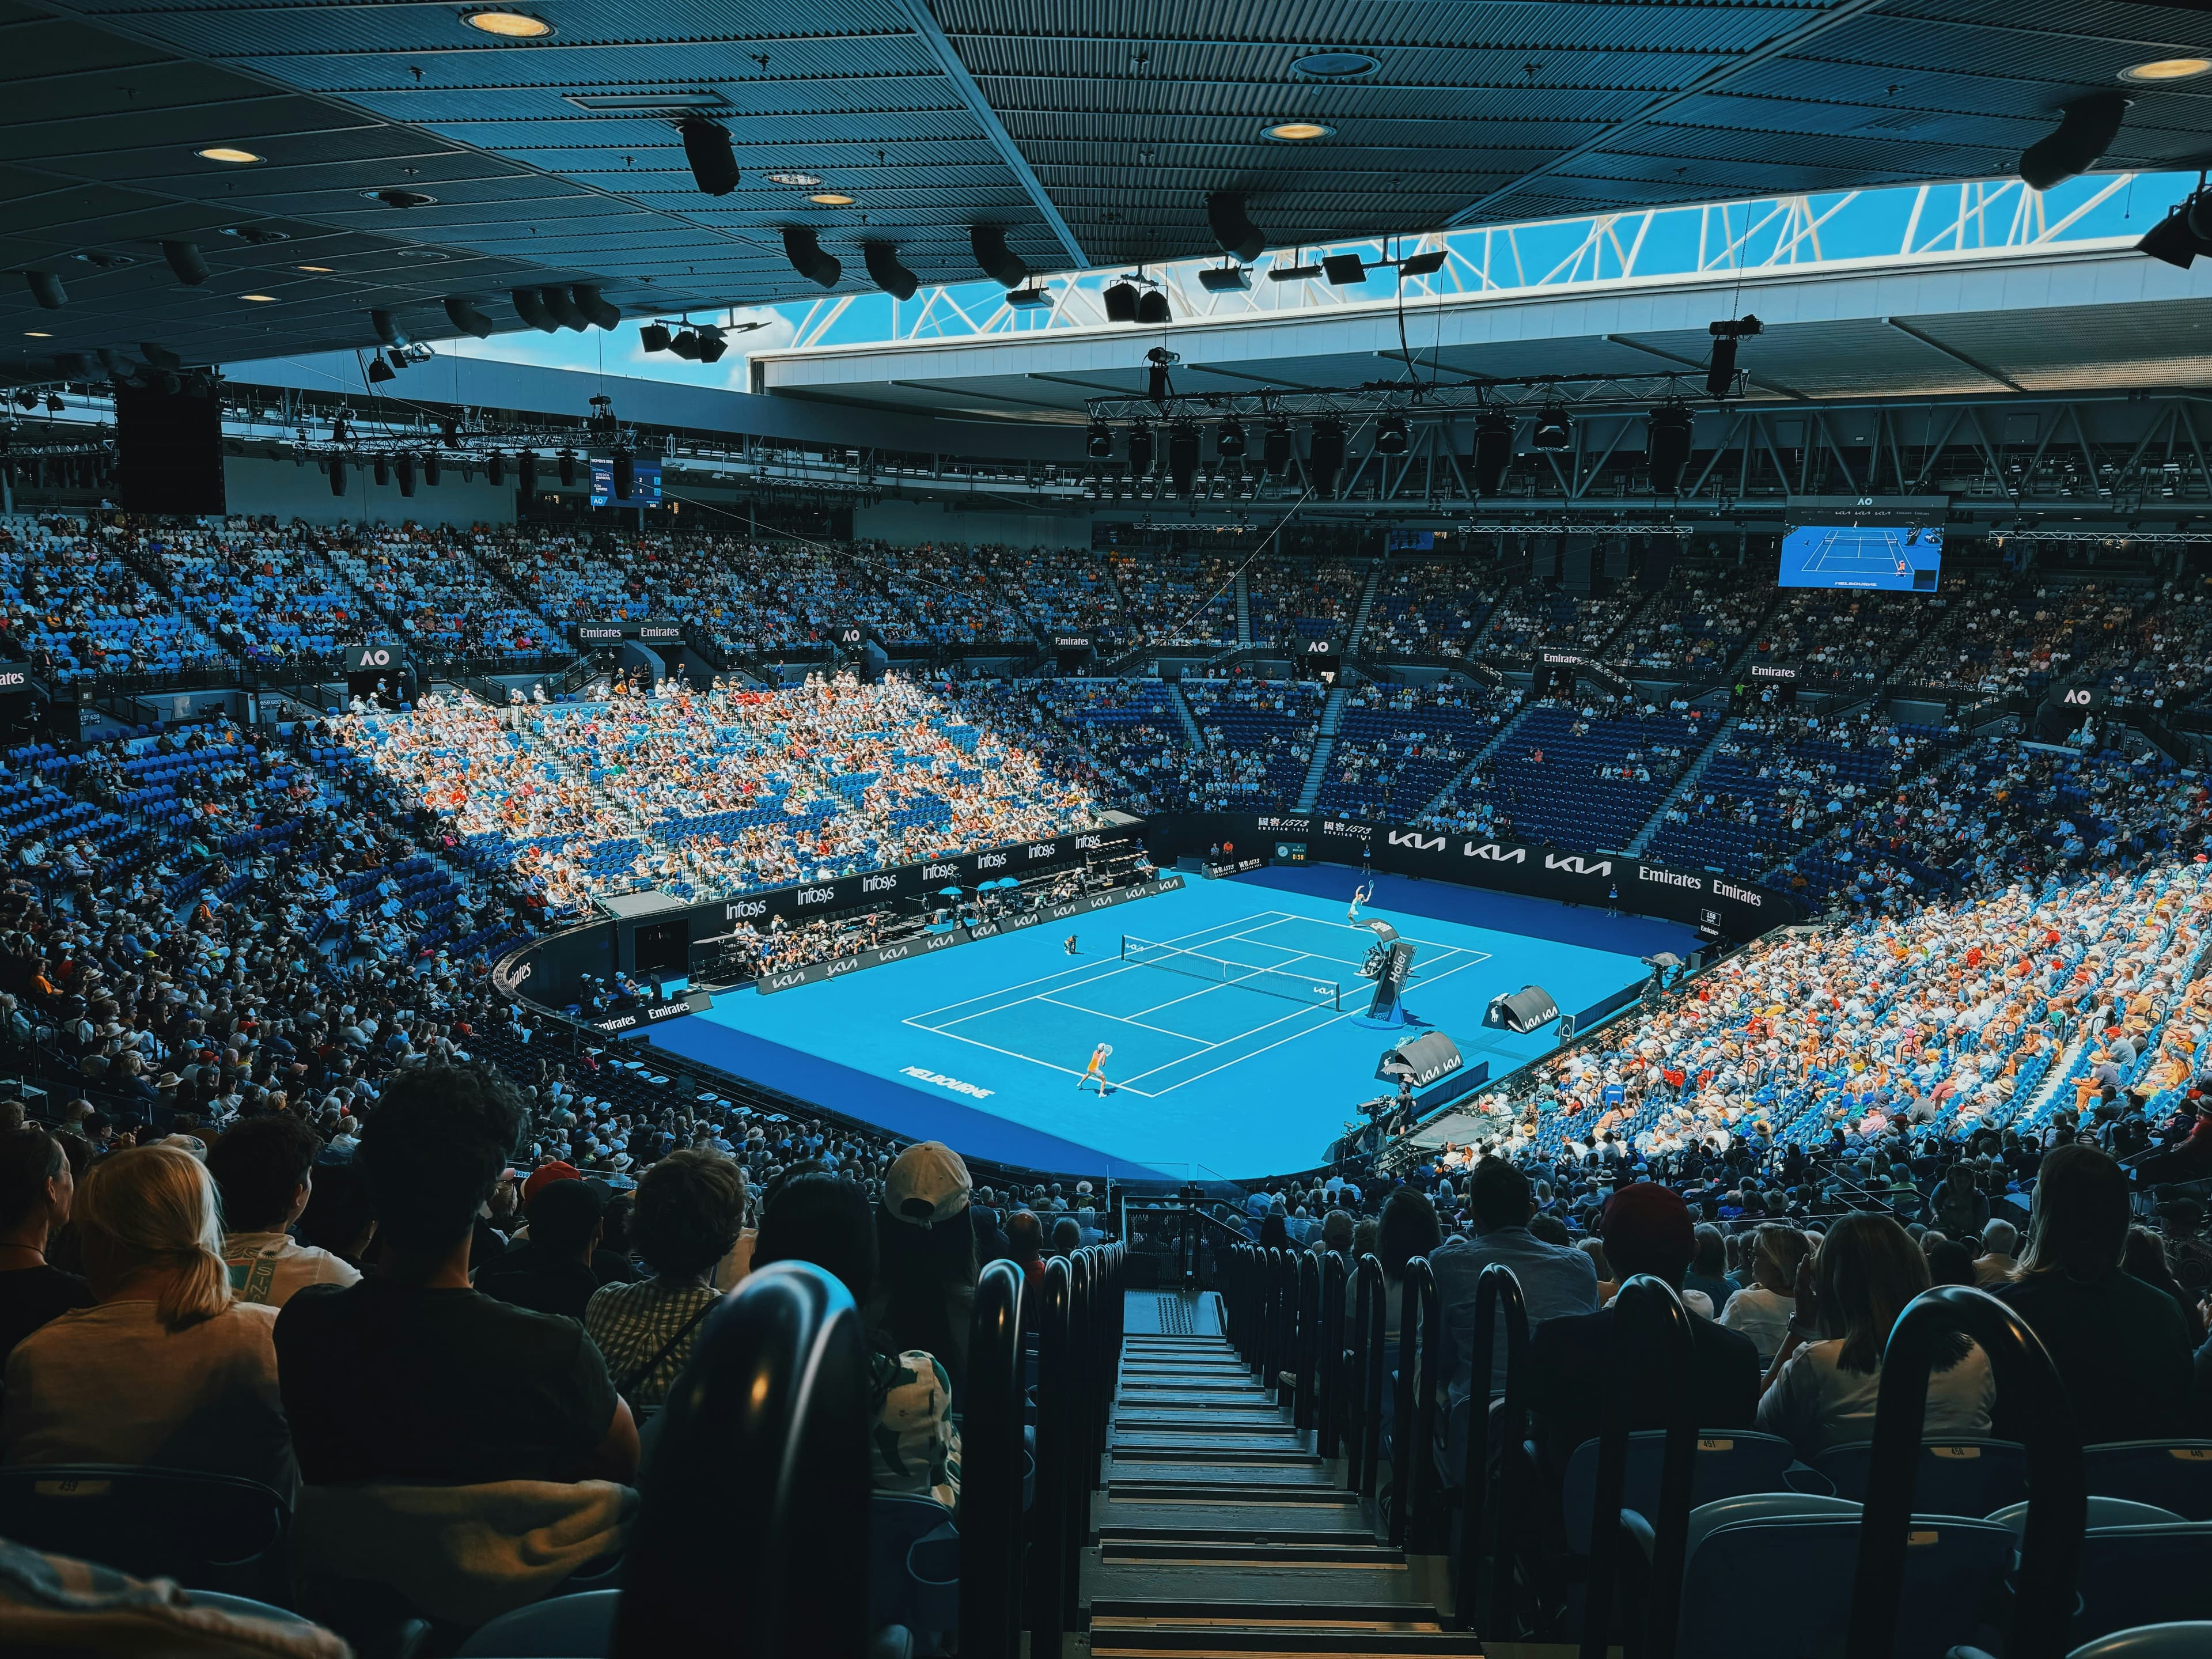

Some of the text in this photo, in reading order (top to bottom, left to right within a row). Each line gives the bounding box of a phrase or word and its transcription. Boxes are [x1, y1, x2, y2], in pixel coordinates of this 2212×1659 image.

[1857, 498, 1873, 506] AO
[580, 627, 622, 638] Emirates
[641, 627, 679, 637] Emirates
[842, 630, 860, 642] AO
[1055, 637, 1089, 645] Emirates
[1308, 641, 1329, 653] AO
[359, 650, 389, 666] AO
[1544, 653, 1582, 664] Emirates
[1752, 665, 1796, 677] Emirates
[2064, 689, 2092, 704] AO
[1075, 834, 1100, 850] Infosys
[1389, 830, 1446, 852] KIA
[1028, 843, 1055, 859] Infosys
[1464, 841, 1526, 864] KIA
[978, 853, 1007, 870] Infosys
[1545, 853, 1612, 877] KIA
[923, 863, 954, 880] Infosys
[1638, 866, 1702, 890] Emirates
[863, 874, 897, 892] Infosys
[1159, 879, 1179, 891] KIA
[797, 885, 834, 906] Infosys
[1126, 886, 1146, 900] KIA
[1713, 878, 1762, 907] Emirates
[1090, 895, 1112, 908] KIA
[726, 898, 767, 921] Infosys
[1053, 904, 1076, 919] KIA
[1706, 912, 1717, 920] 158
[1014, 912, 1038, 928] KIA
[972, 923, 997, 938] KIA
[1700, 925, 1719, 935] Emirates
[927, 933, 954, 950] KIA
[1126, 942, 1144, 952] KIA
[879, 945, 908, 962] KIA
[827, 957, 858, 976] KIA
[1389, 950, 1407, 983] Haier
[772, 971, 805, 990] KIA
[1313, 986, 1335, 996] KIA
[647, 1002, 690, 1020] Emirates
[1542, 1006, 1558, 1020] KIA
[594, 1016, 636, 1031] mirates
[1525, 1016, 1540, 1029] KIA
[1443, 1055, 1461, 1071] KIA
[899, 1065, 996, 1099] MELBOURNE
[1421, 1068, 1440, 1083] KIA
[1703, 1440, 1715, 1448] 451
